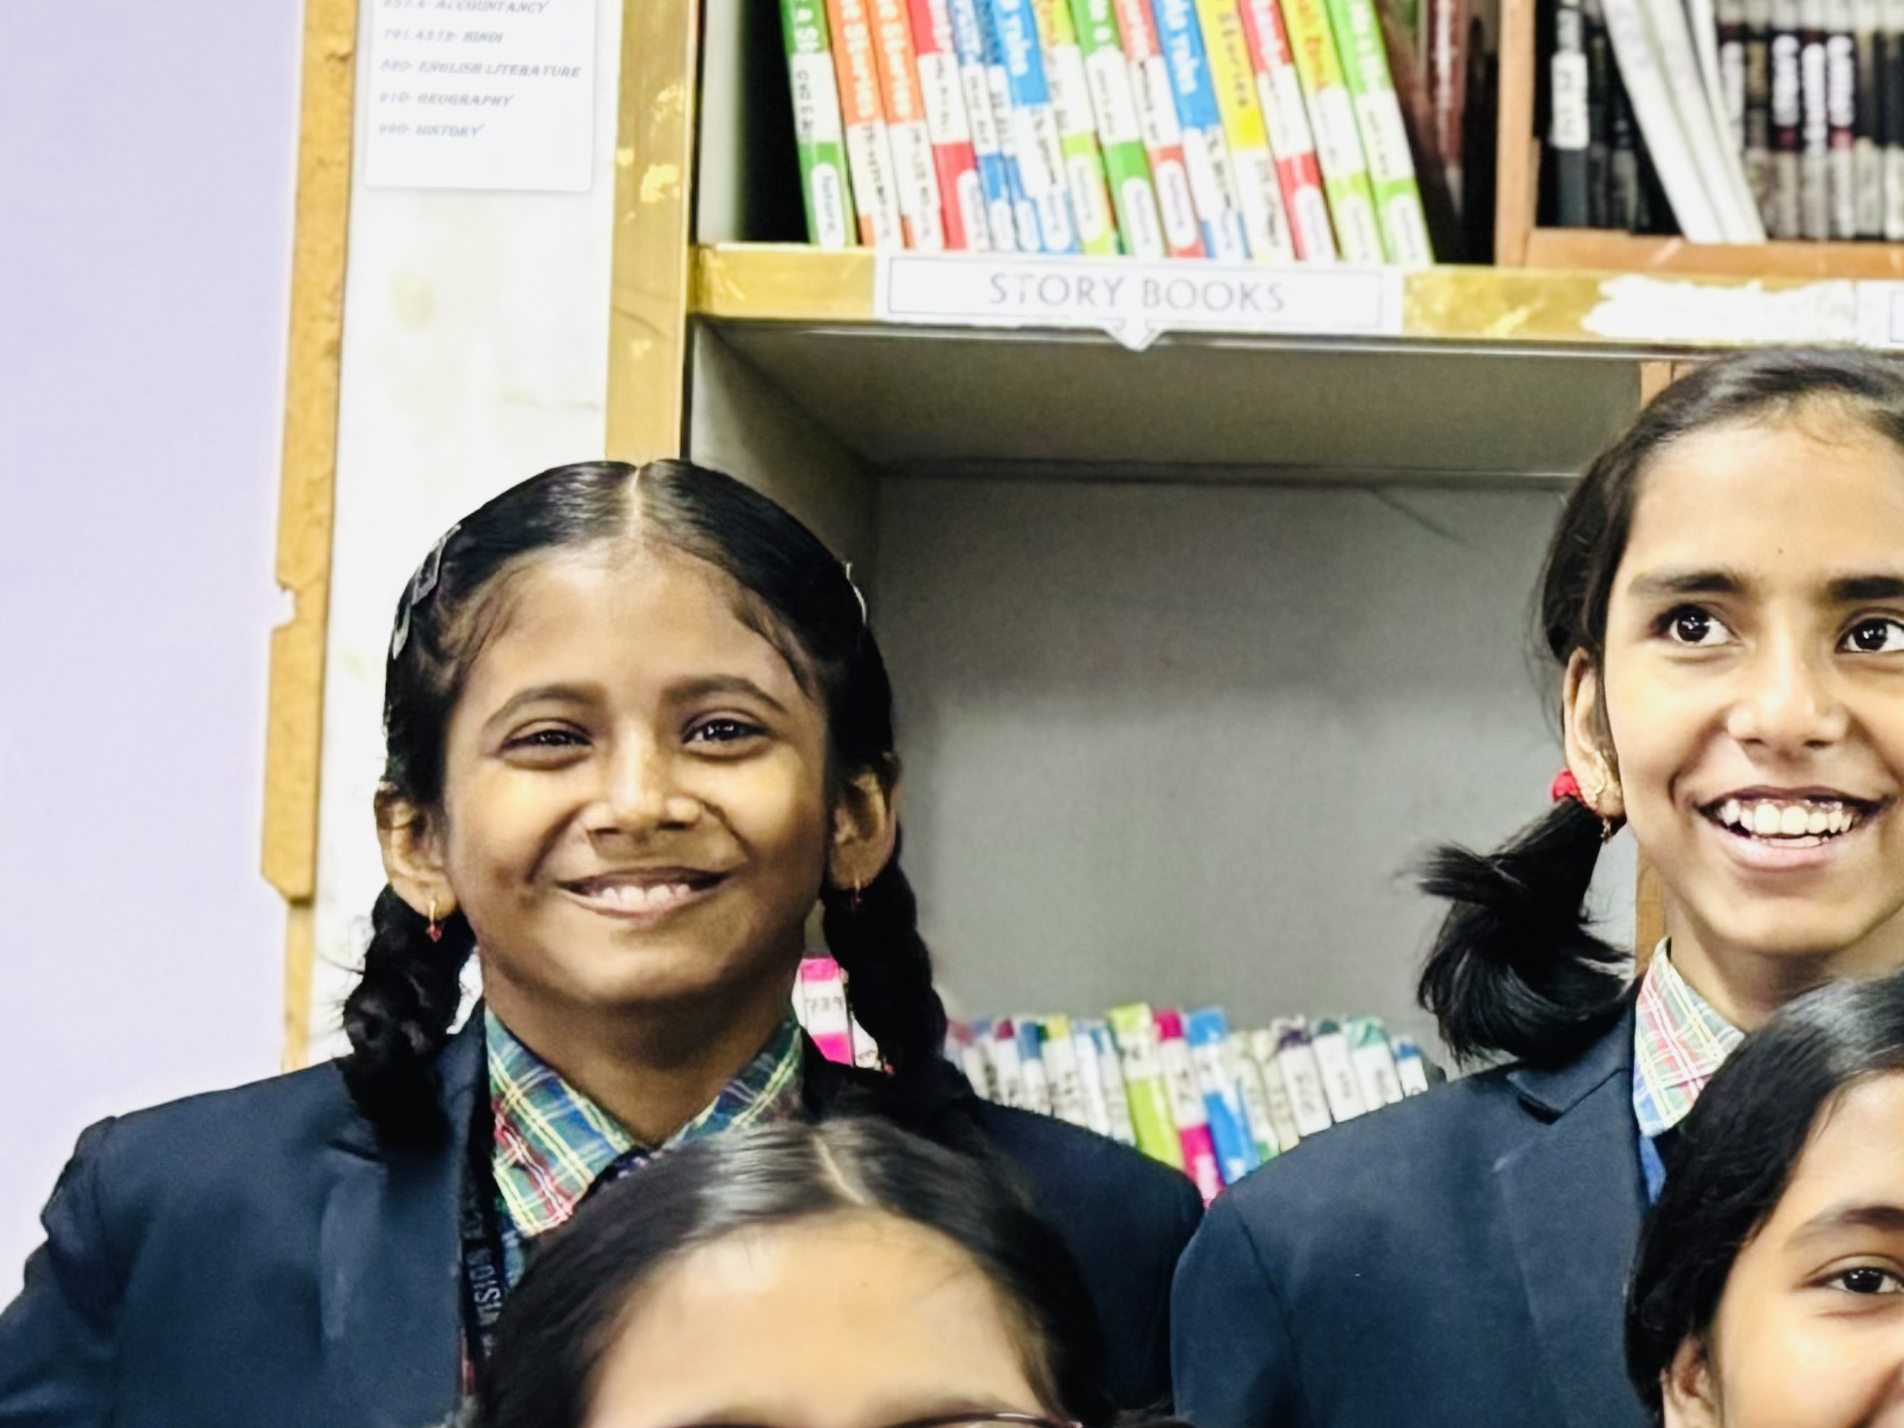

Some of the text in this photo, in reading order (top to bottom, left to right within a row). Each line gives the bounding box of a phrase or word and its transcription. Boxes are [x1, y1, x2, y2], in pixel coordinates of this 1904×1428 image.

[844, 22, 875, 119] Stories
[880, 22, 912, 118] Stories
[1003, 12, 1033, 77] Tales
[1172, 34, 1199, 94] Tales
[990, 273, 1286, 313] STORY BOOKS
